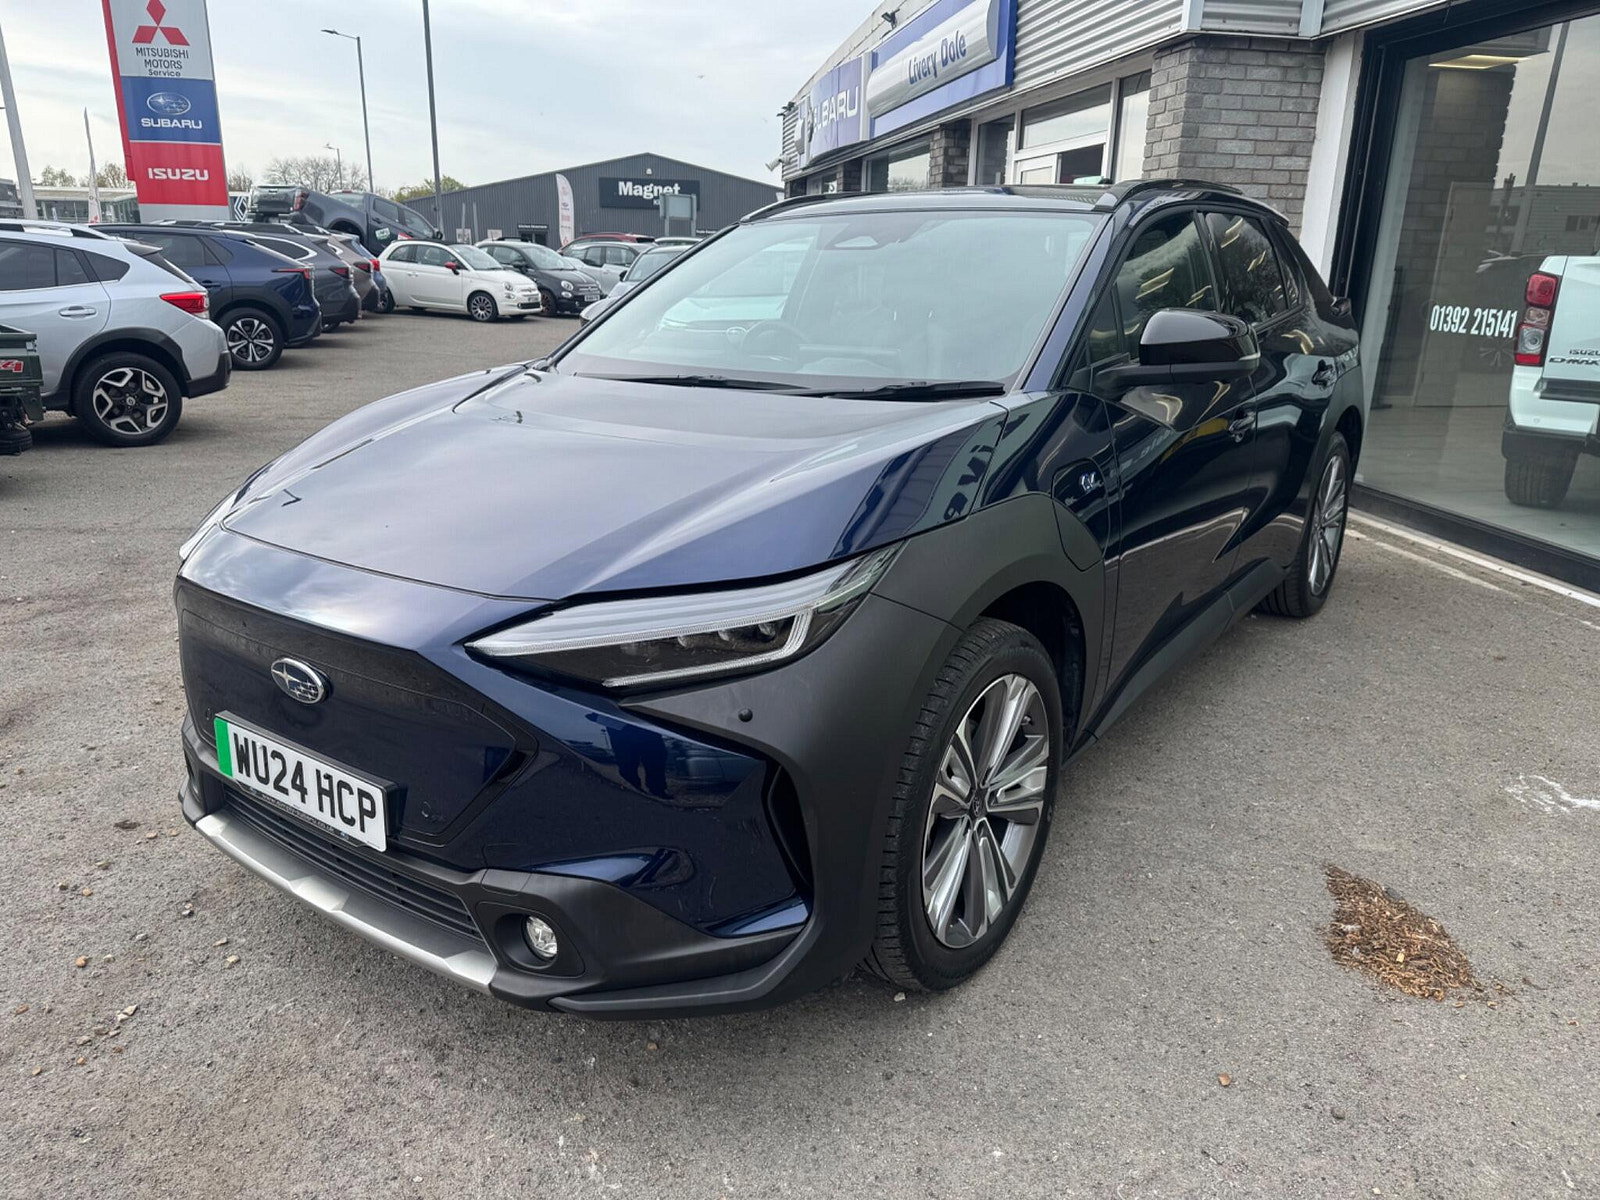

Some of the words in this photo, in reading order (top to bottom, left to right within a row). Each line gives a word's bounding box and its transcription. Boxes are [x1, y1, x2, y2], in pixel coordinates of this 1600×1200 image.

[136, 47, 189, 59] MITSUBISHI
[909, 51, 937, 84] Livery
[941, 30, 966, 67] Dole
[144, 59, 183, 69] MOTORS
[148, 69, 181, 77] Service
[141, 118, 202, 129] SUBARU
[148, 167, 209, 181] ISUZU
[618, 181, 680, 199] Magnet
[1430, 305, 1470, 334] 01392
[1470, 308, 1518, 338] 215141
[233, 732, 308, 804] WU24
[315, 768, 377, 834] HCP
